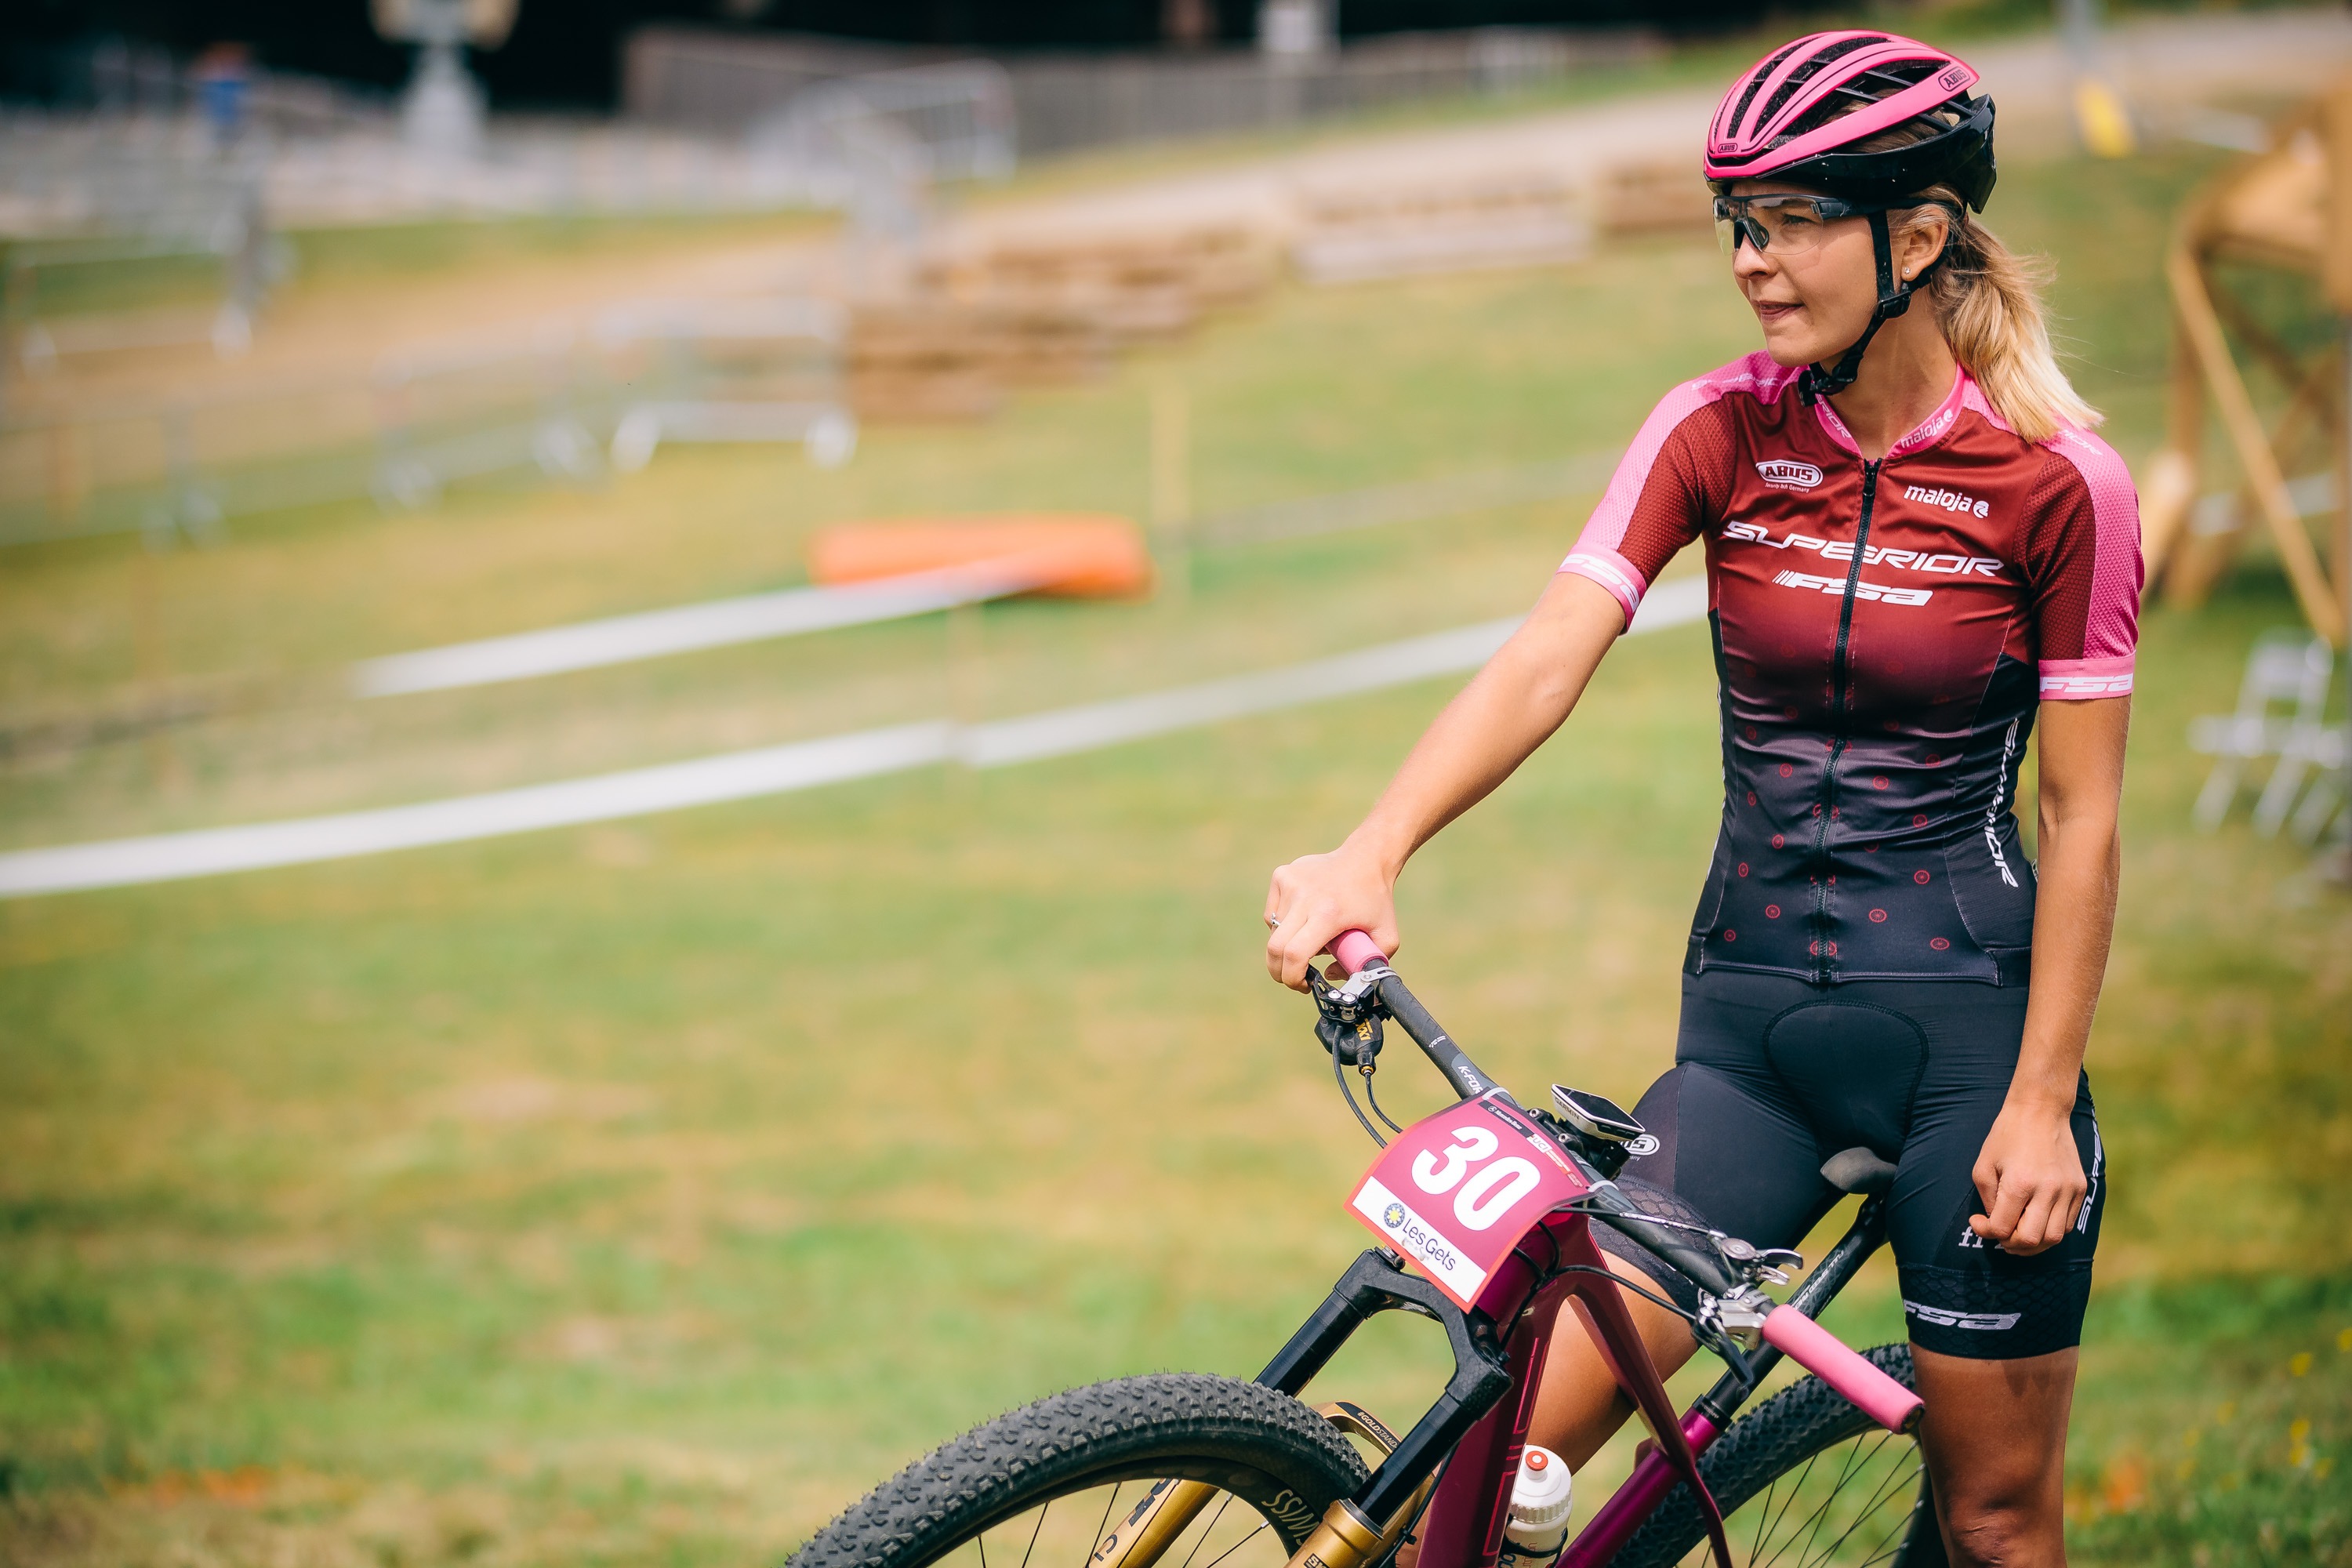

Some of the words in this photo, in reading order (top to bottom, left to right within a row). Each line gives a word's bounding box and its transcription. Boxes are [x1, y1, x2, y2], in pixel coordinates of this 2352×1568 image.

[1943, 69, 1967, 88] ABUS
[1900, 417, 1944, 449] maloja
[1765, 466, 1813, 481] ABUS
[1903, 485, 1973, 513] maloja
[1722, 520, 2005, 578] SUPERIOR
[1555, 1098, 1580, 1120] GARMIN
[1532, 1136, 1548, 1151] UCI
[1411, 1125, 1541, 1231] 30
[1402, 1218, 1426, 1245] Les
[1425, 1238, 1456, 1271] Gets
